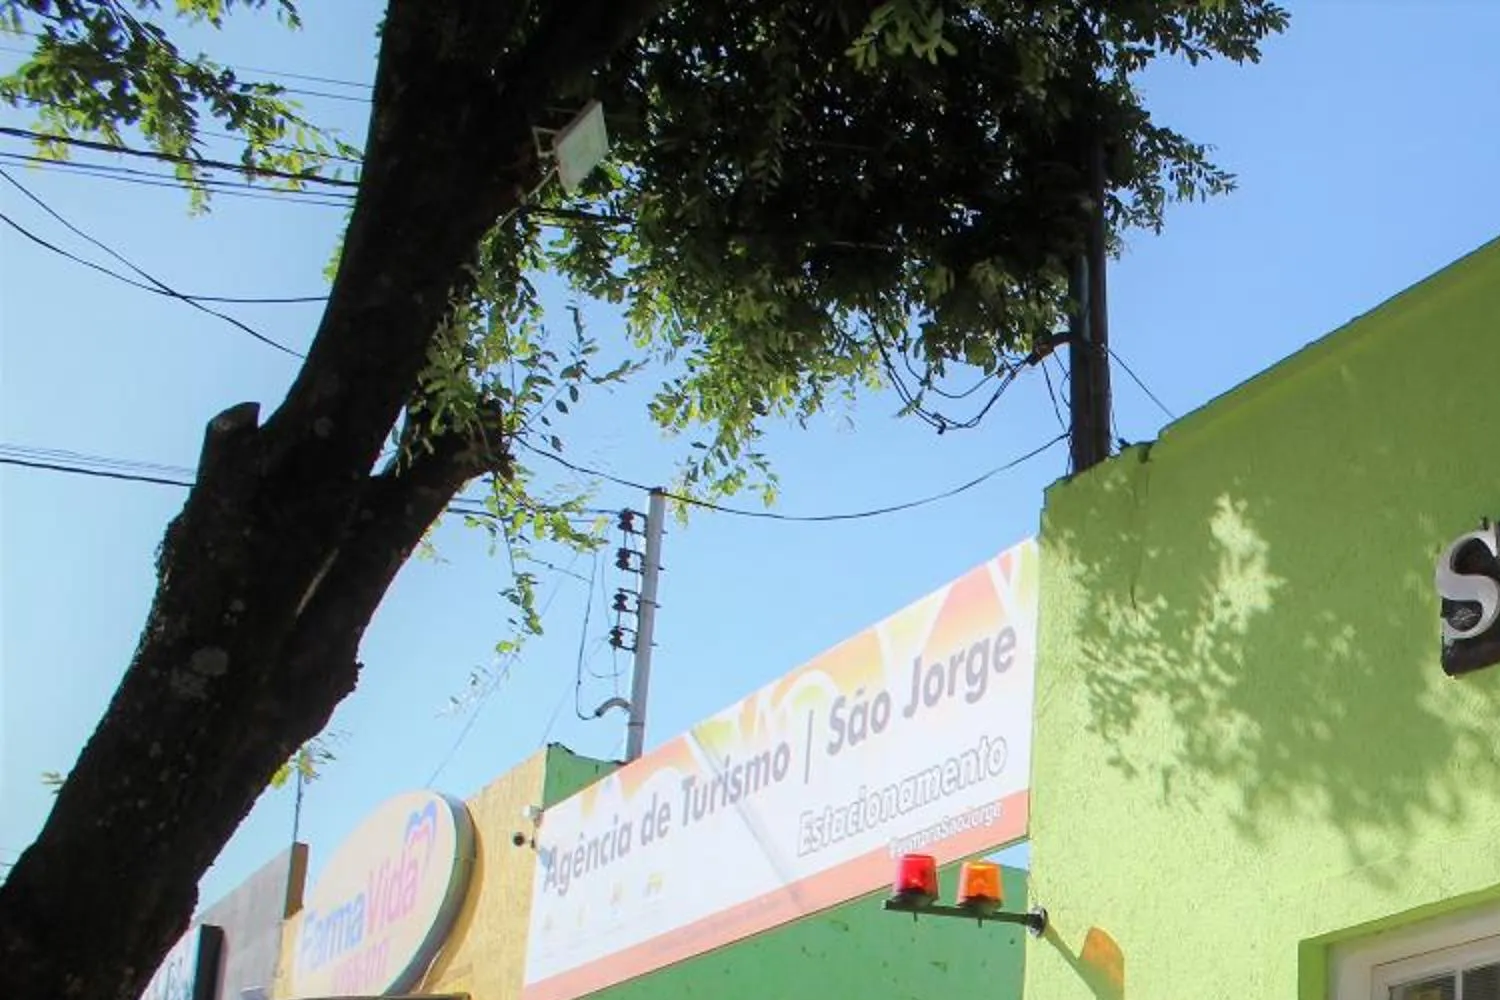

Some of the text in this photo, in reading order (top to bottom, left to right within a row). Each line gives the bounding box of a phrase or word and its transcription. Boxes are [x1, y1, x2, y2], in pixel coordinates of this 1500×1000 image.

[542, 625, 1017, 898] Agência de Turismo São Jorge
[798, 735, 1009, 857] Estacionamento
